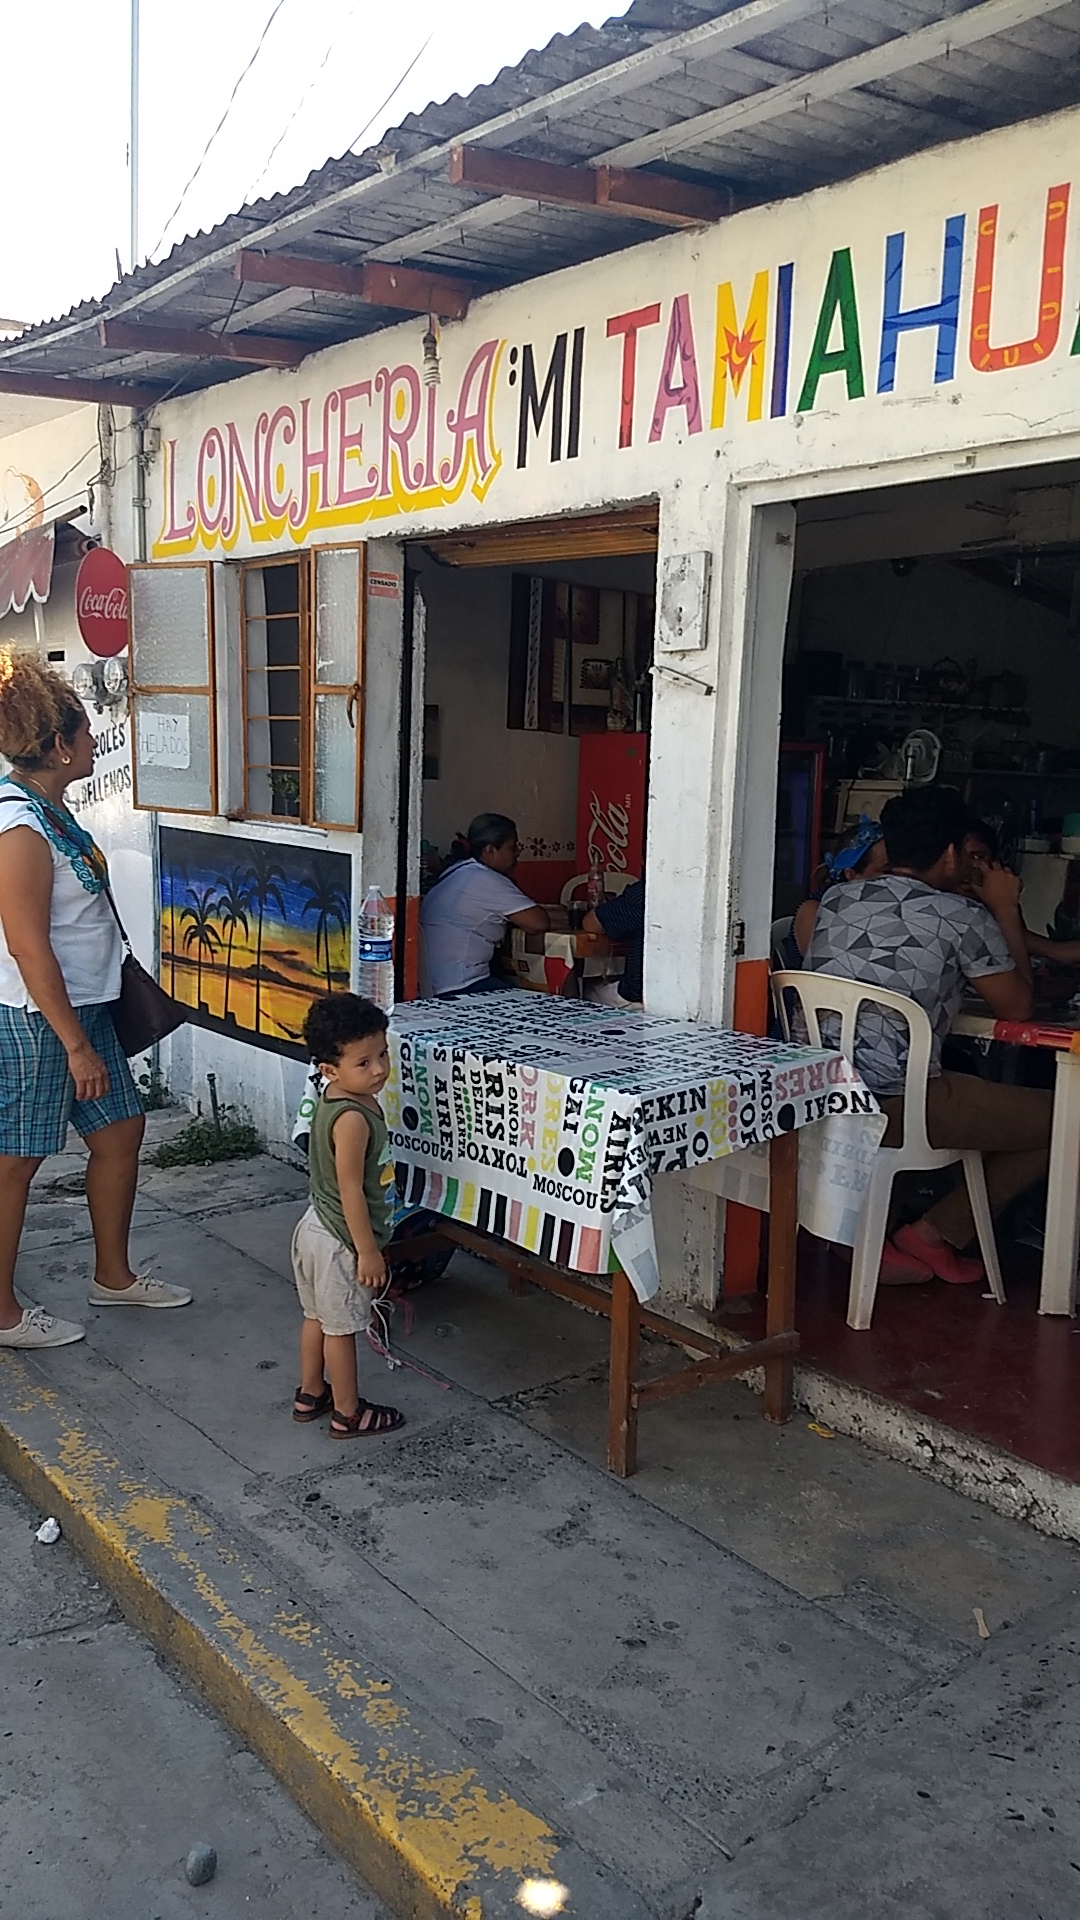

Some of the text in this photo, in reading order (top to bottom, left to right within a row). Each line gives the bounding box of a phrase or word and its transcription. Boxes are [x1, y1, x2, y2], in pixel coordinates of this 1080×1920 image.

[516, 326, 585, 469] MI
[605, 181, 1080, 448] TAMIAHU
[370, 579, 397, 588] CENSADO
[157, 716, 178, 732] HAY
[141, 734, 189, 757] HELADOS
[470, 1069, 484, 1135] DELHI
[508, 1086, 519, 1147] HONG
[453, 1085, 466, 1158] JAKARTA
[466, 1142, 527, 1178] TOKYO
[532, 1173, 598, 1209] MOSCOU
